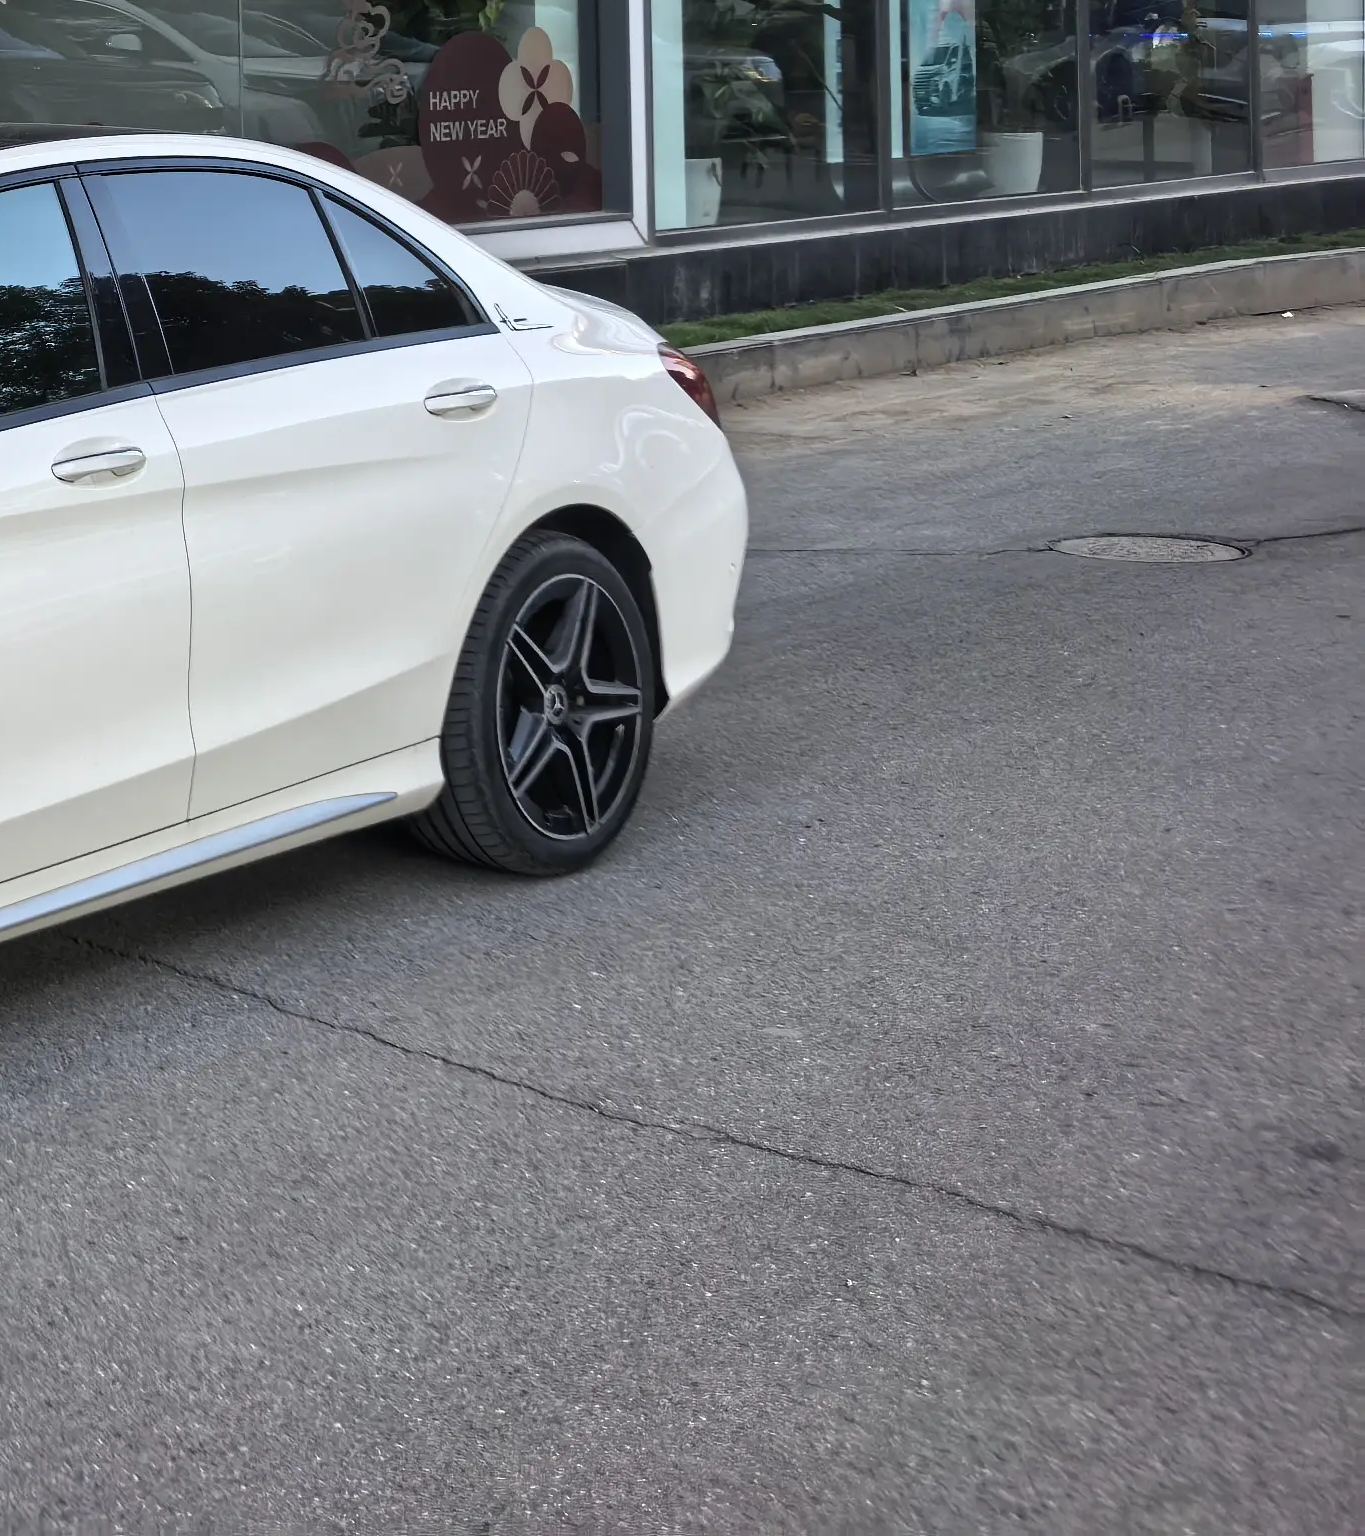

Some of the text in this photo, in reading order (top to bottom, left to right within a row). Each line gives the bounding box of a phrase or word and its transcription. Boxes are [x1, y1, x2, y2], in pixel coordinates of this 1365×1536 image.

[429, 90, 480, 111] HAPPY
[430, 118, 508, 142] NEW YEAR
